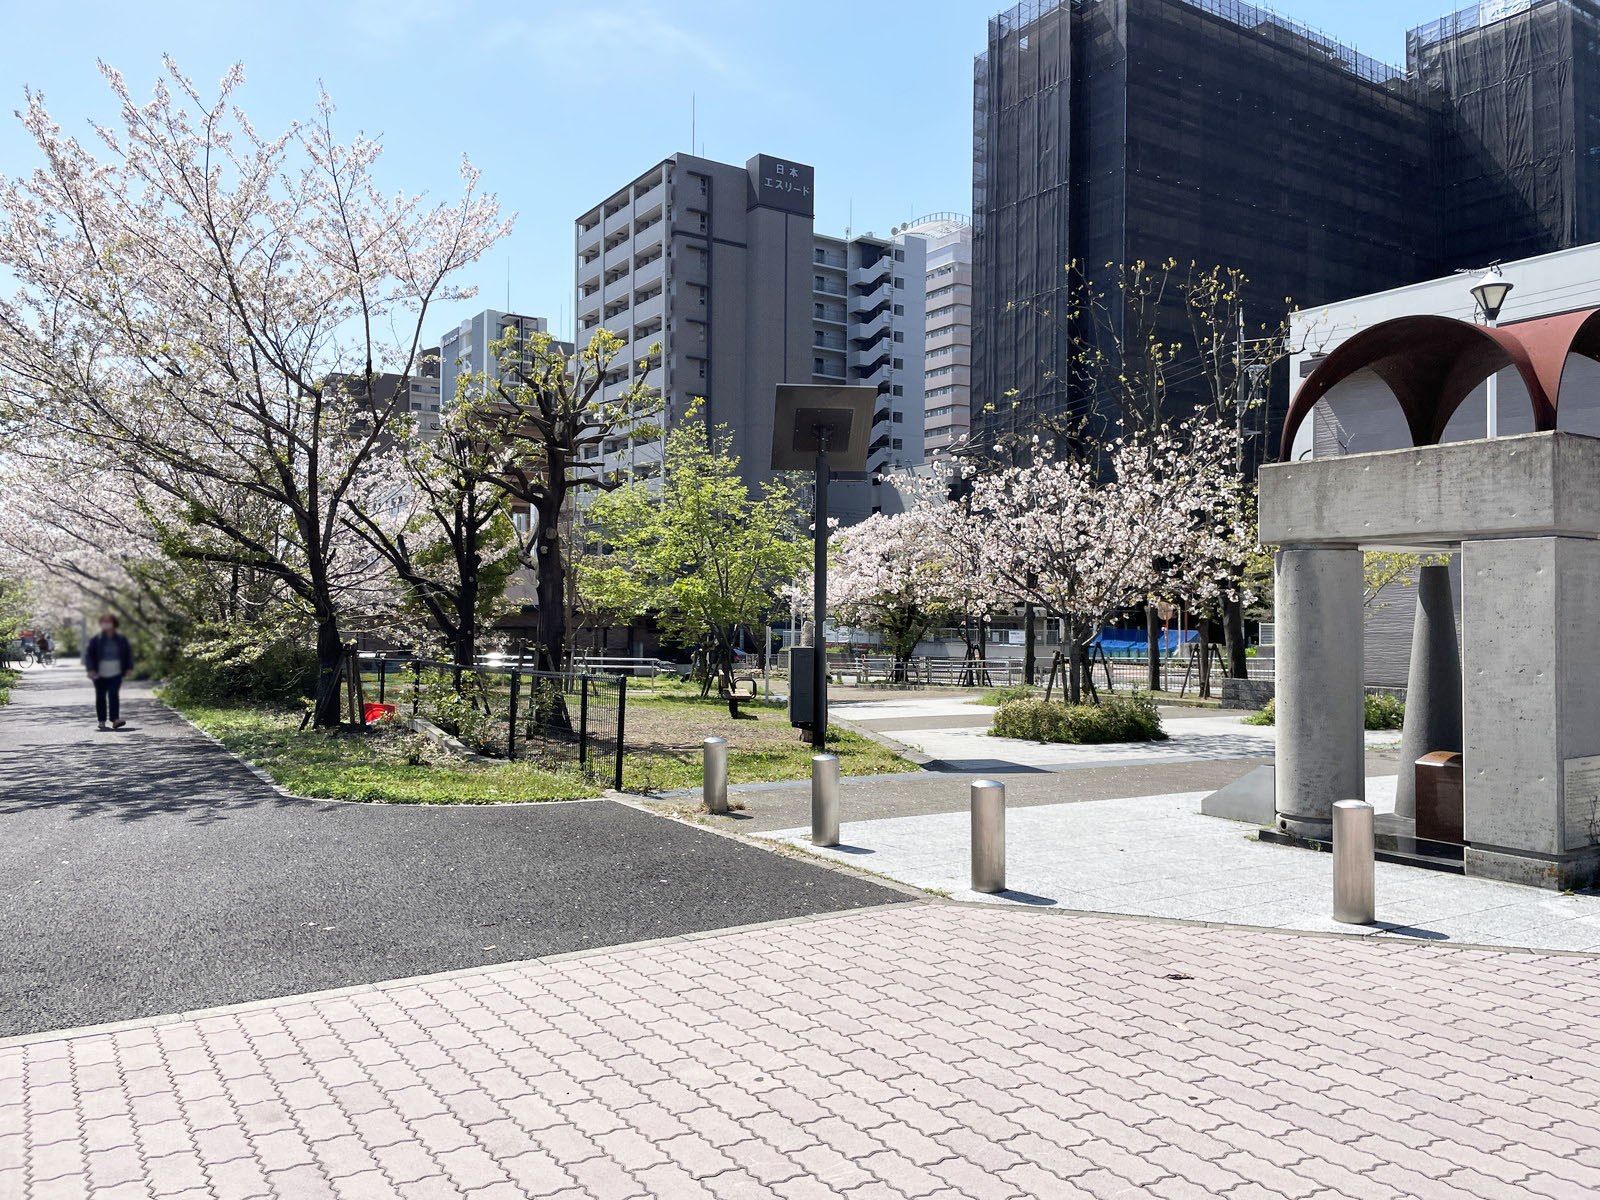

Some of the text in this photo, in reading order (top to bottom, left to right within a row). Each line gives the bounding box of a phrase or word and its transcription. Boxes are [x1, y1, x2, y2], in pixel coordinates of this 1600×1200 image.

[776, 164, 799, 178] 日本
[764, 177, 809, 196] エスリード
